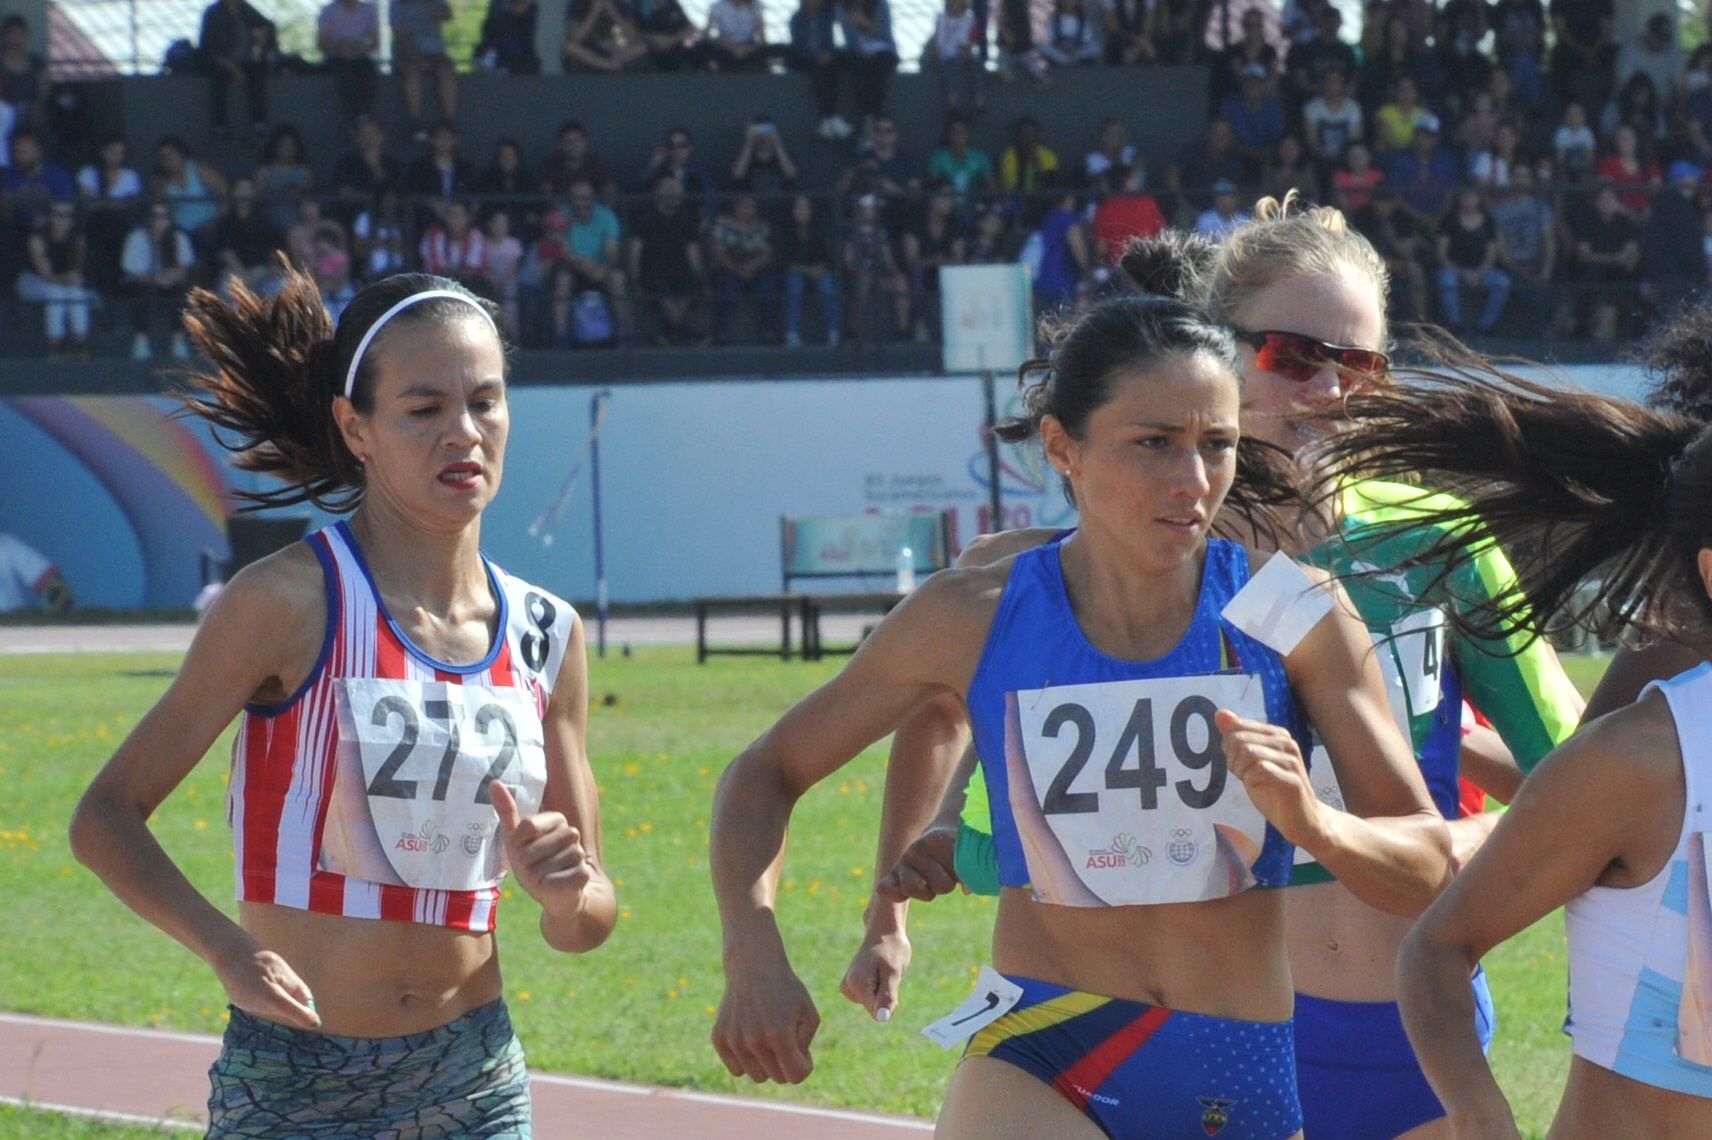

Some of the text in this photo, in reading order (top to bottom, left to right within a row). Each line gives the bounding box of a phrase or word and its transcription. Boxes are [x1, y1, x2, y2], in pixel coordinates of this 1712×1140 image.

[520, 591, 555, 673] 8
[1423, 626, 1439, 681] 4
[367, 694, 519, 805] 272
[1041, 695, 1229, 816] 249
